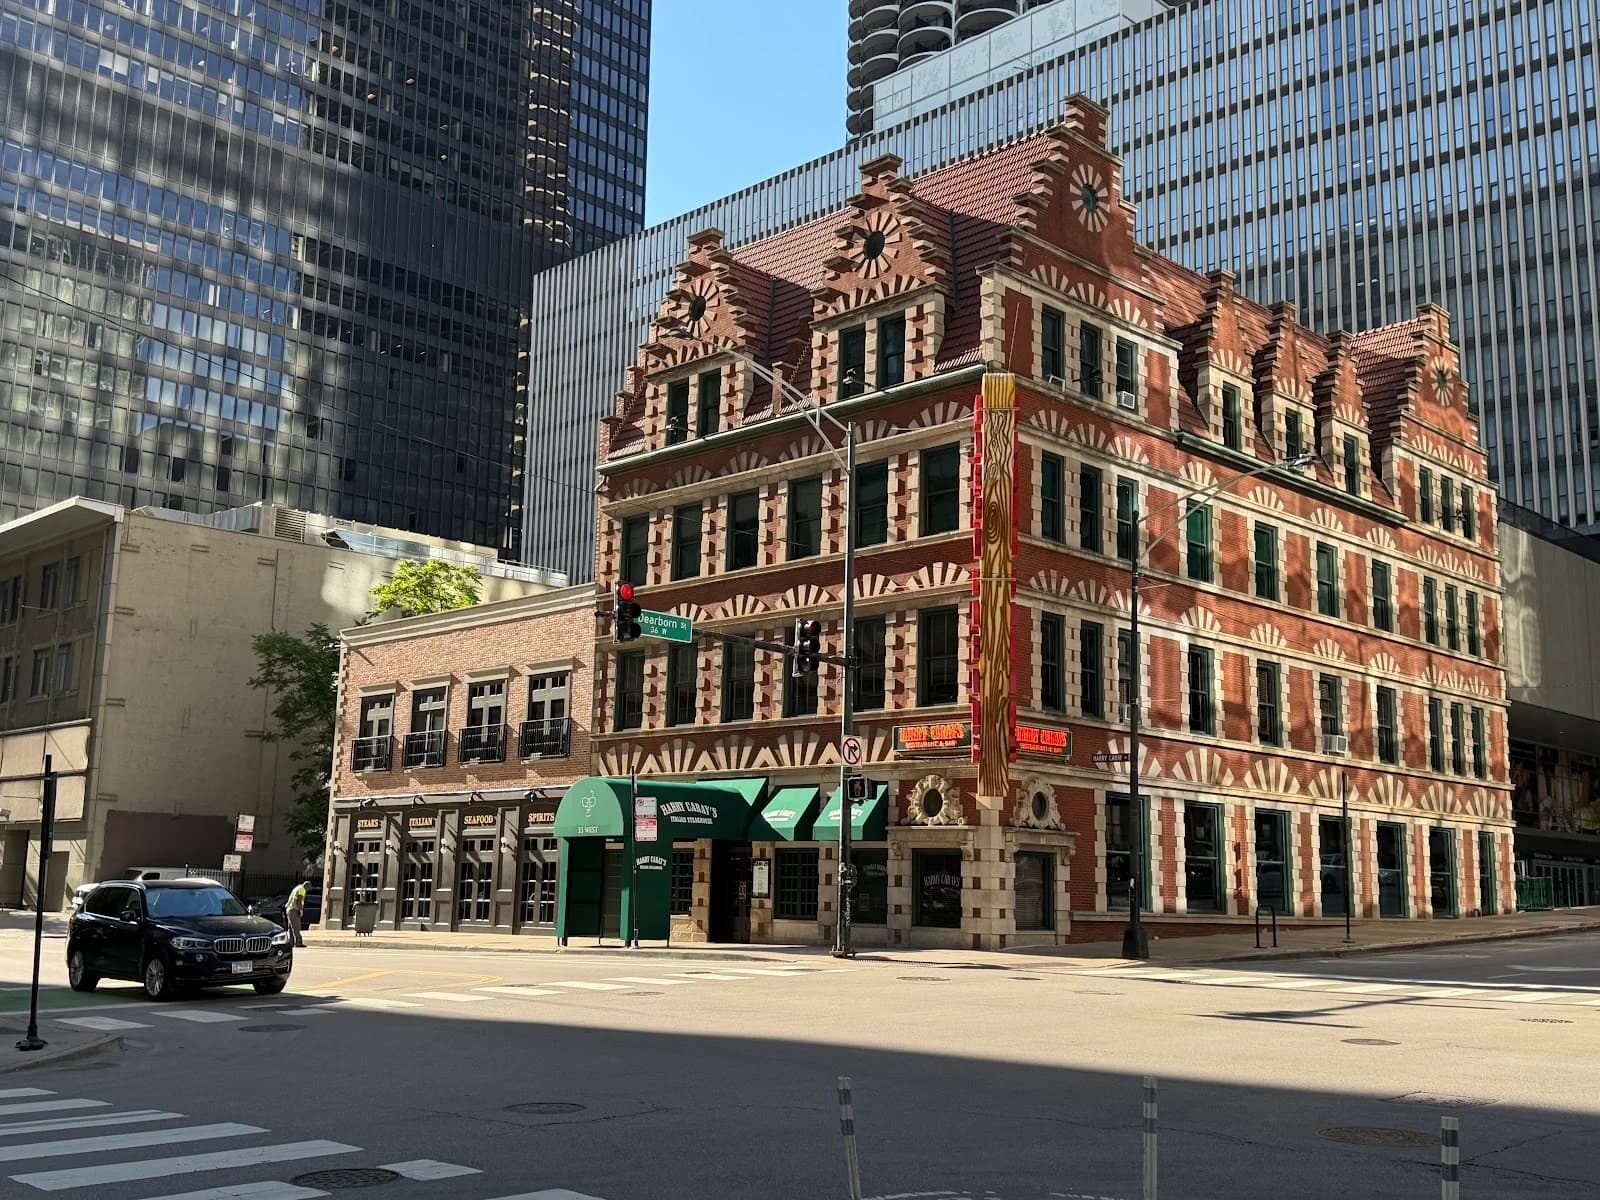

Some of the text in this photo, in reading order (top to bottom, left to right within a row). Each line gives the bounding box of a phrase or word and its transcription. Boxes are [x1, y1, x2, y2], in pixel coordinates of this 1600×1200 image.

[638, 614, 677, 628] Dearborn
[650, 626, 658, 634] 36
[660, 801, 685, 816] HARRY
[685, 801, 718, 818] CARAY'S
[409, 818, 433, 826] ITALIAN
[463, 815, 494, 825] SEAFOOD
[528, 812, 555, 822] SPIRITS
[357, 819, 379, 828] STEAKS
[636, 856, 650, 866] HARRY
